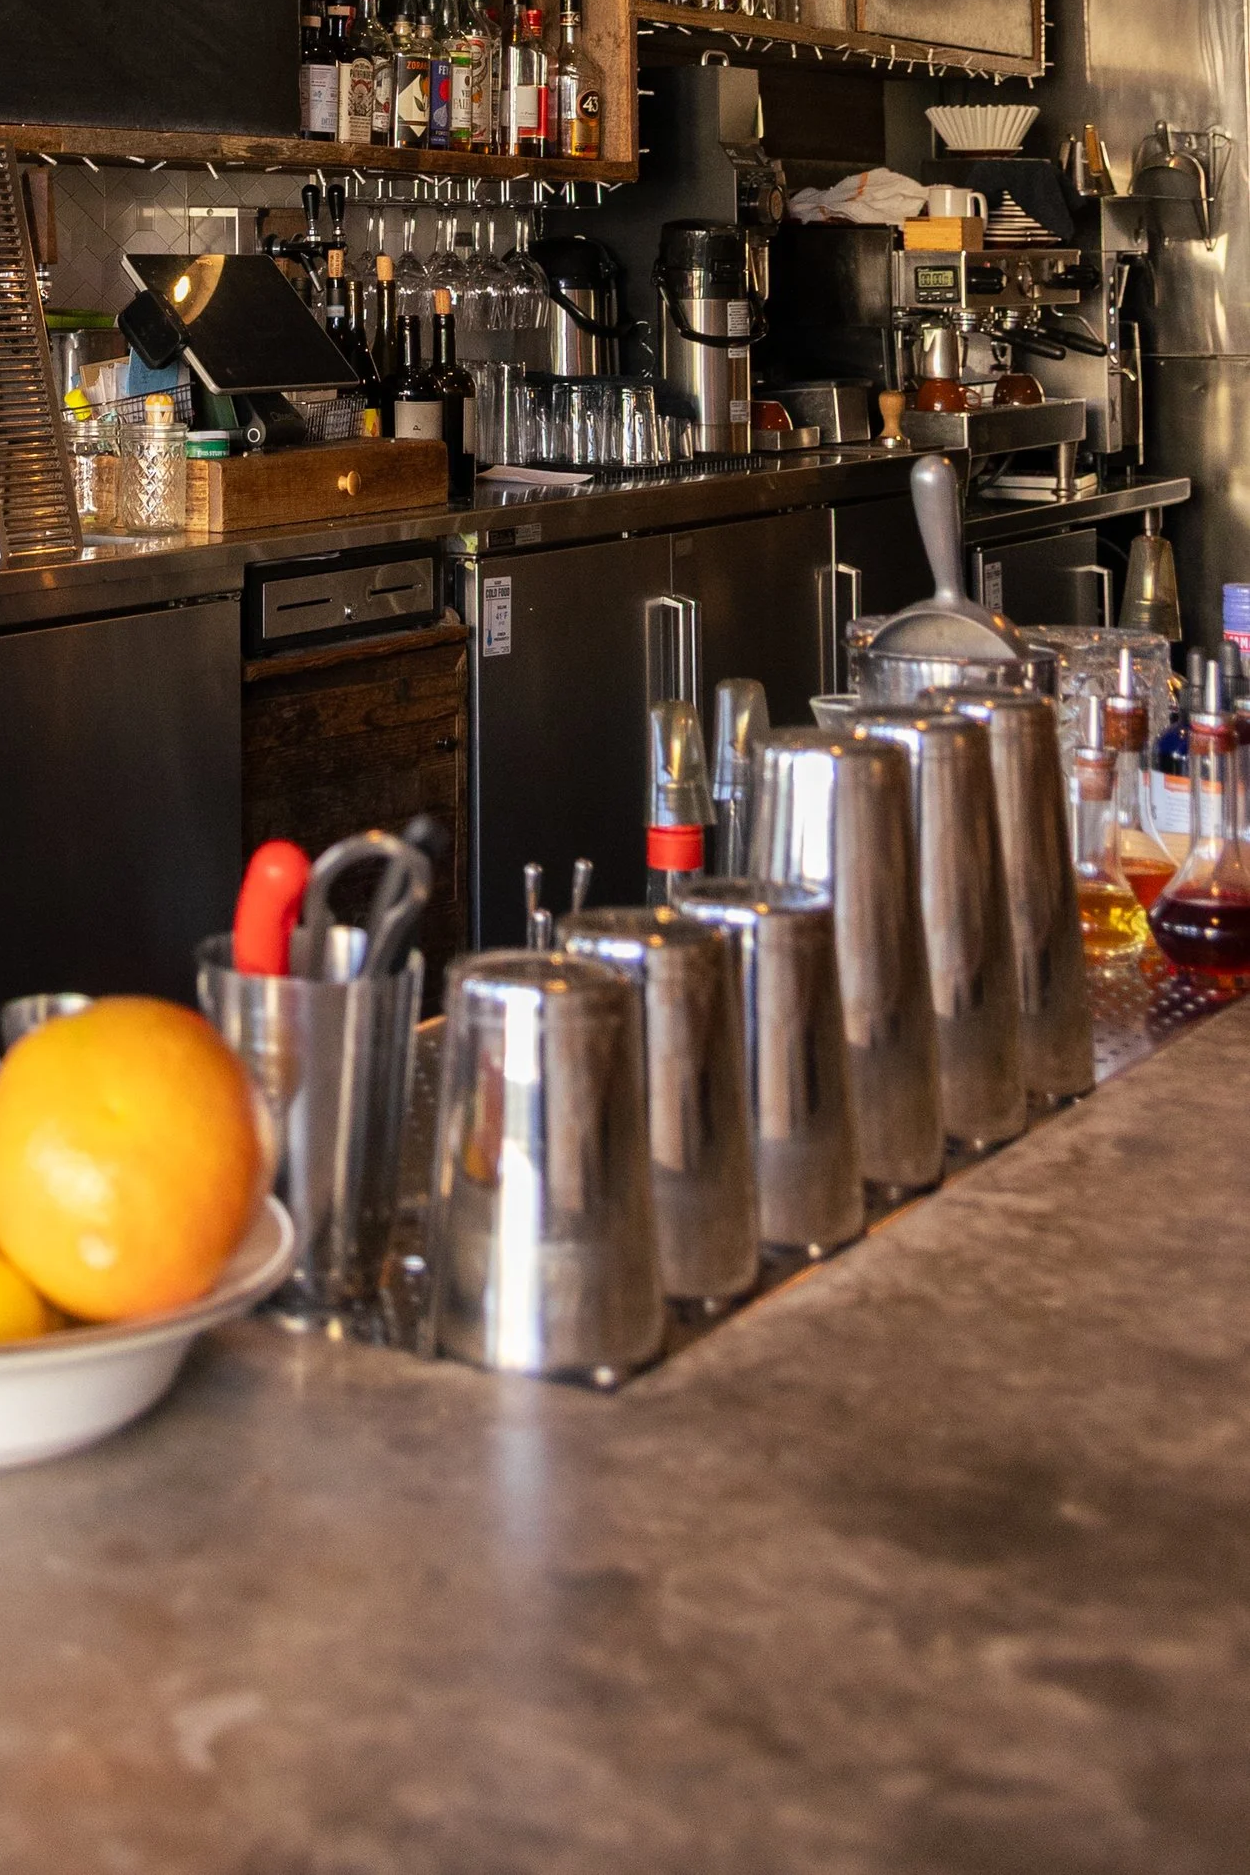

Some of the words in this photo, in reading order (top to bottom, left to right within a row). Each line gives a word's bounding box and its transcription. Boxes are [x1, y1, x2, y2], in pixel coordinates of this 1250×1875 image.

[583, 96, 599, 113] 43
[485, 588, 497, 598] COLD
[498, 587, 510, 597] FOOD
